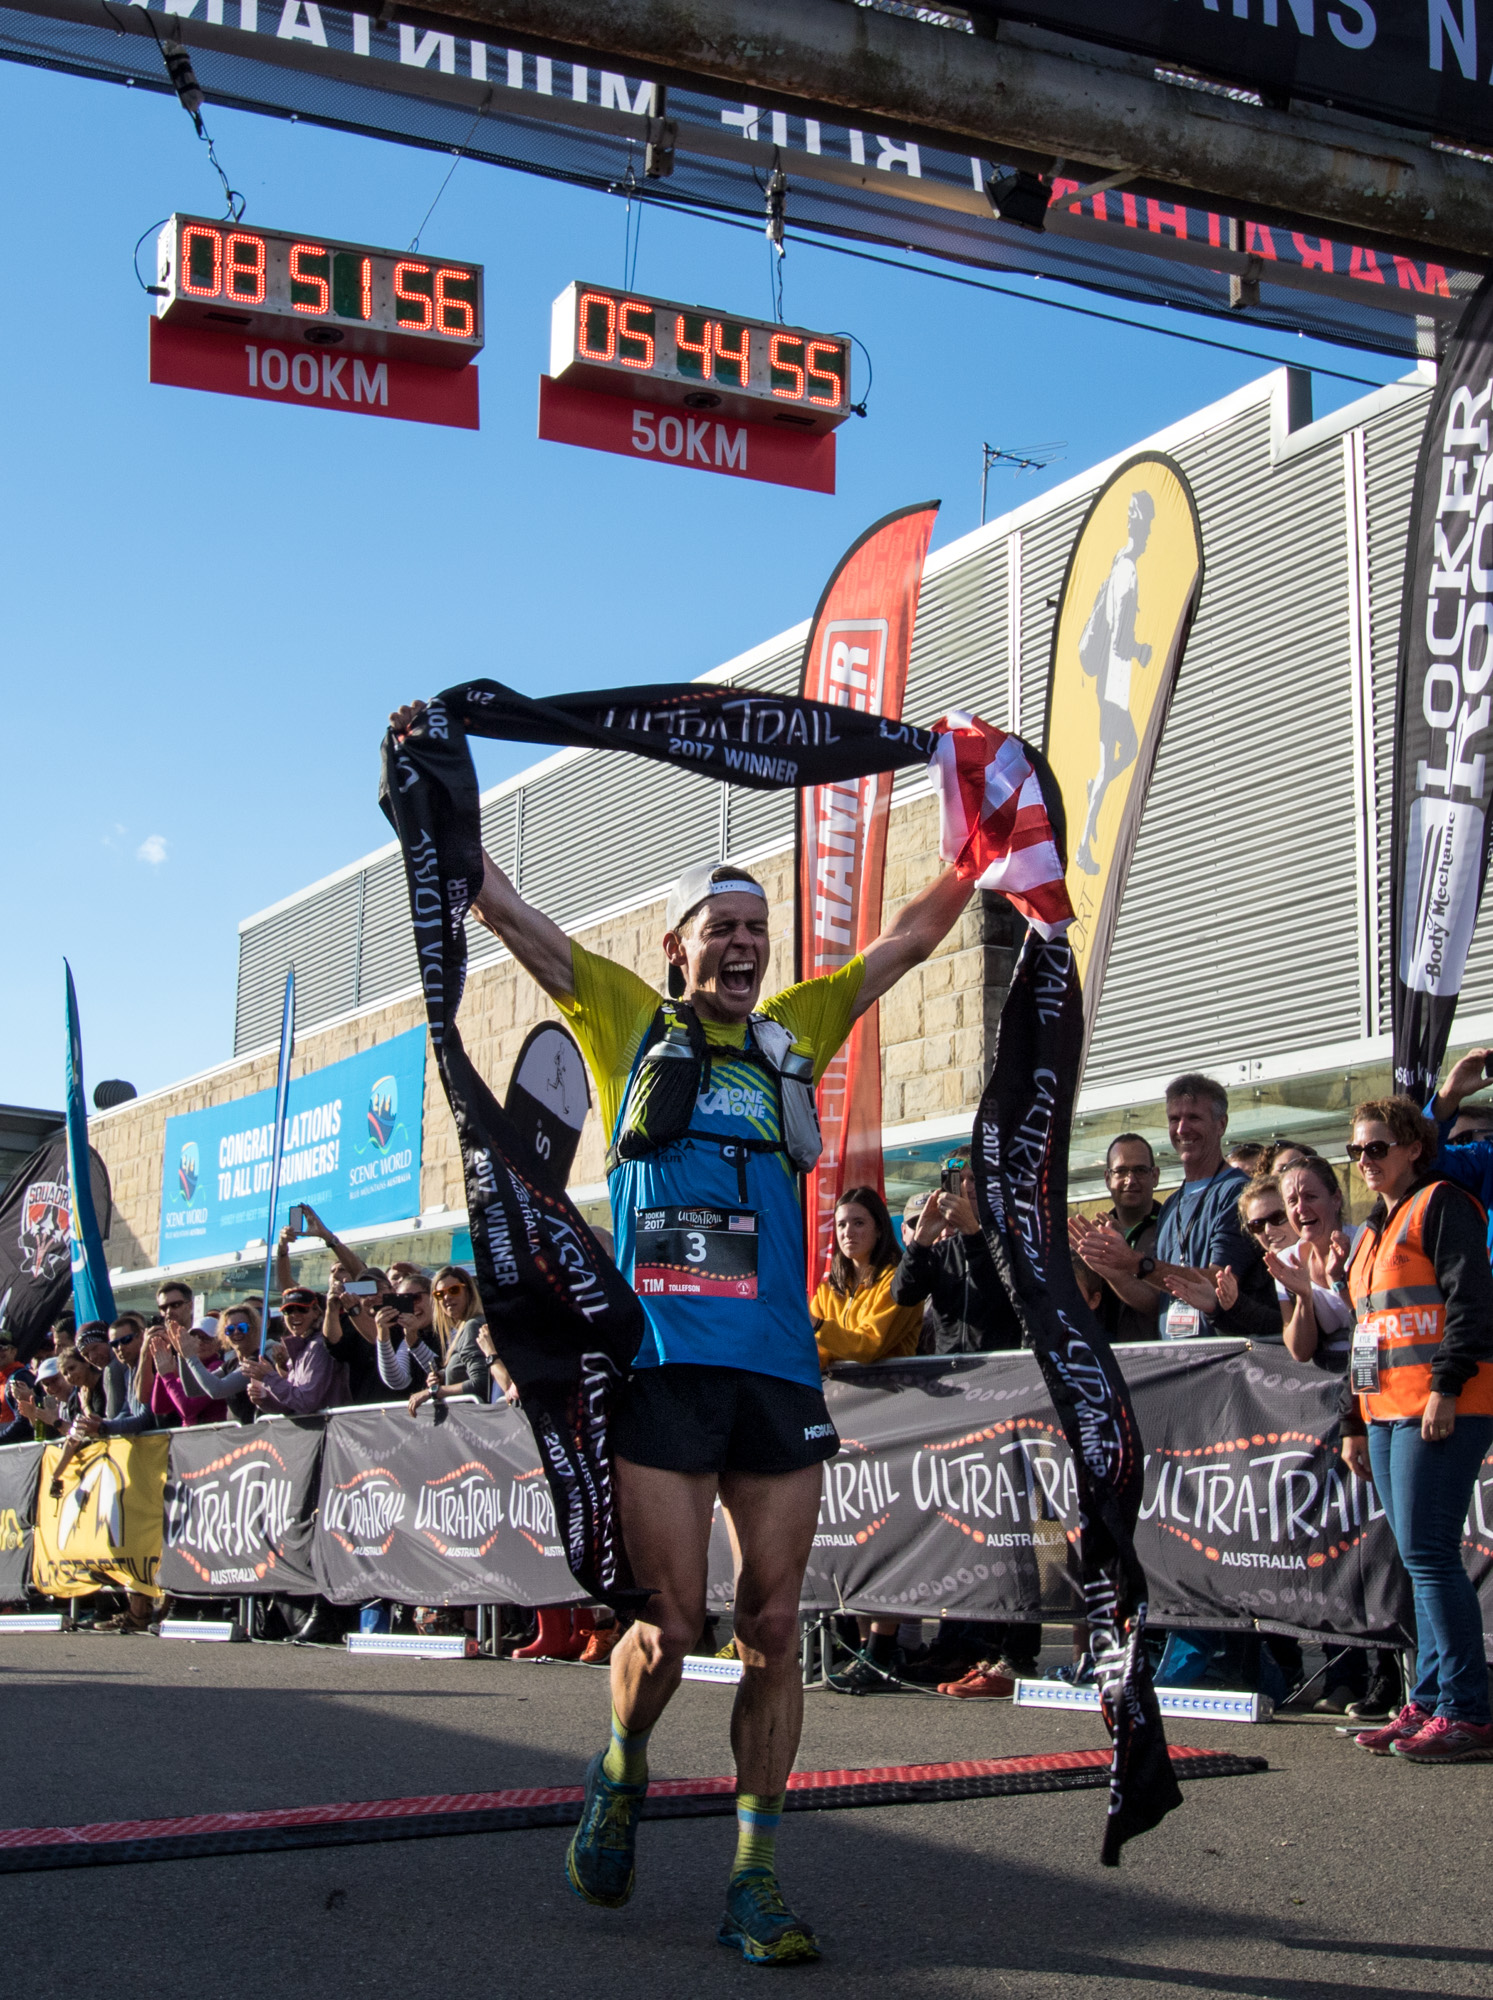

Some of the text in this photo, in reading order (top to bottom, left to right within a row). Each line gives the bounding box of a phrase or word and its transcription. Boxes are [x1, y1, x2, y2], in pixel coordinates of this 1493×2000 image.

[245, 344, 389, 406] 100KM
[631, 409, 748, 471] 50KM
[1416, 378, 1493, 795] LOCKER
[668, 738, 799, 785] 2017 WINNER
[1425, 811, 1456, 987] Body Mechanic
[1072, 882, 1092, 953] ORT
[729, 1088, 764, 1106] ONE
[731, 1102, 766, 1119] ONE
[219, 1099, 342, 1169] CONGRATLATIONS
[982, 1121, 1000, 1167] 2017
[217, 1169, 231, 1202] TO
[232, 1164, 252, 1198] ALL
[279, 1139, 340, 1188] RUNNERS!
[350, 1149, 412, 1187] SCENIC WORLD
[185, 1207, 208, 1226] WORLD
[473, 1147, 520, 1287] 2017 WINNER
[644, 1219, 666, 1230] 2017
[645, 1211, 666, 1220] 100KM
[685, 1232, 707, 1263] 3
[642, 1278, 701, 1293] TIM TOLLEFSON
[1377, 1310, 1437, 1341] CREW
[544, 1431, 576, 1478] 2017
[576, 1452, 599, 1537] AUSTRALIA
[352, 1546, 385, 1556] AUSTRALIA
[445, 1546, 482, 1557] AUSTRALIA
[986, 1530, 1066, 1549] AUSTRALIA
[211, 1567, 259, 1586] AUSTRALIA
[1221, 1550, 1307, 1571] AUSTRALIA
